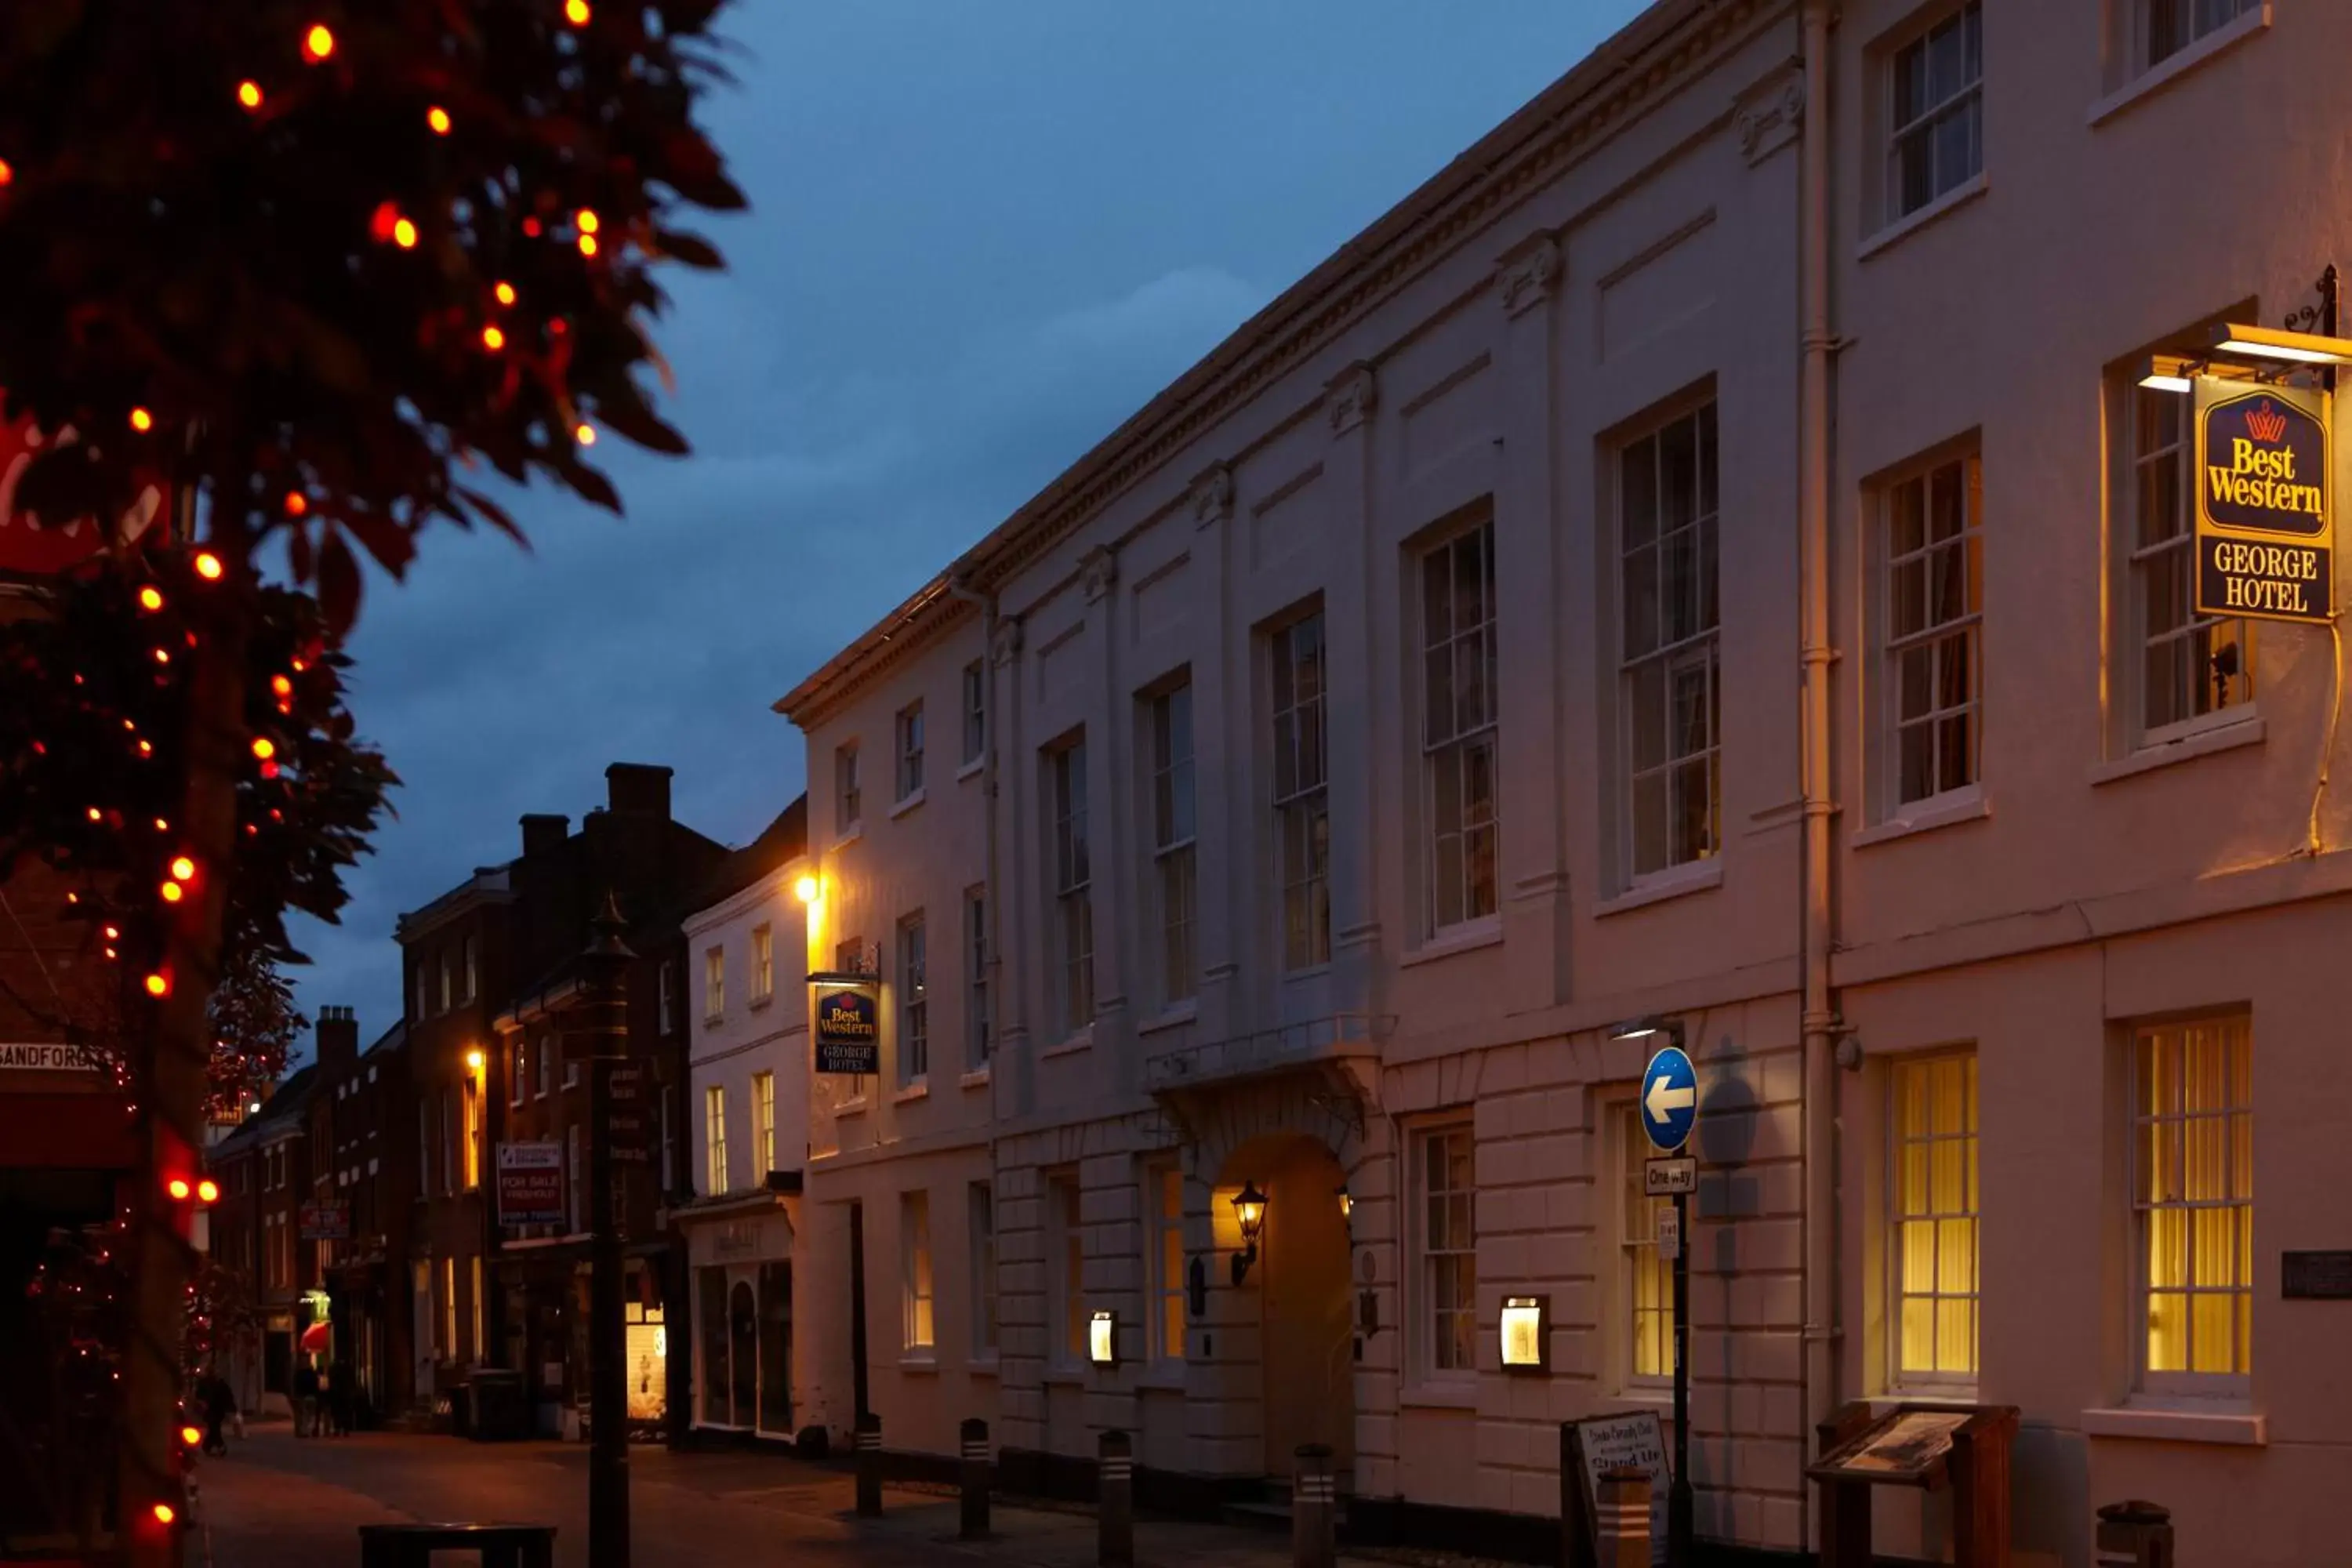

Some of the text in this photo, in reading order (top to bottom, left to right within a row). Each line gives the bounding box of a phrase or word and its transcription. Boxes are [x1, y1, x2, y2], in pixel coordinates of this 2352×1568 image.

[2232, 437, 2296, 481] Best
[2208, 466, 2323, 514] Western
[2214, 542, 2318, 580] GEORGE
[2225, 576, 2308, 612] HOTEL
[831, 1007, 861, 1022] Best
[821, 1018, 873, 1035] Western
[823, 1045, 871, 1060] GEORGE
[829, 1058, 866, 1071] HOTEL
[502, 1174, 559, 1189] FOR SALE
[1650, 1169, 1691, 1186] One way
